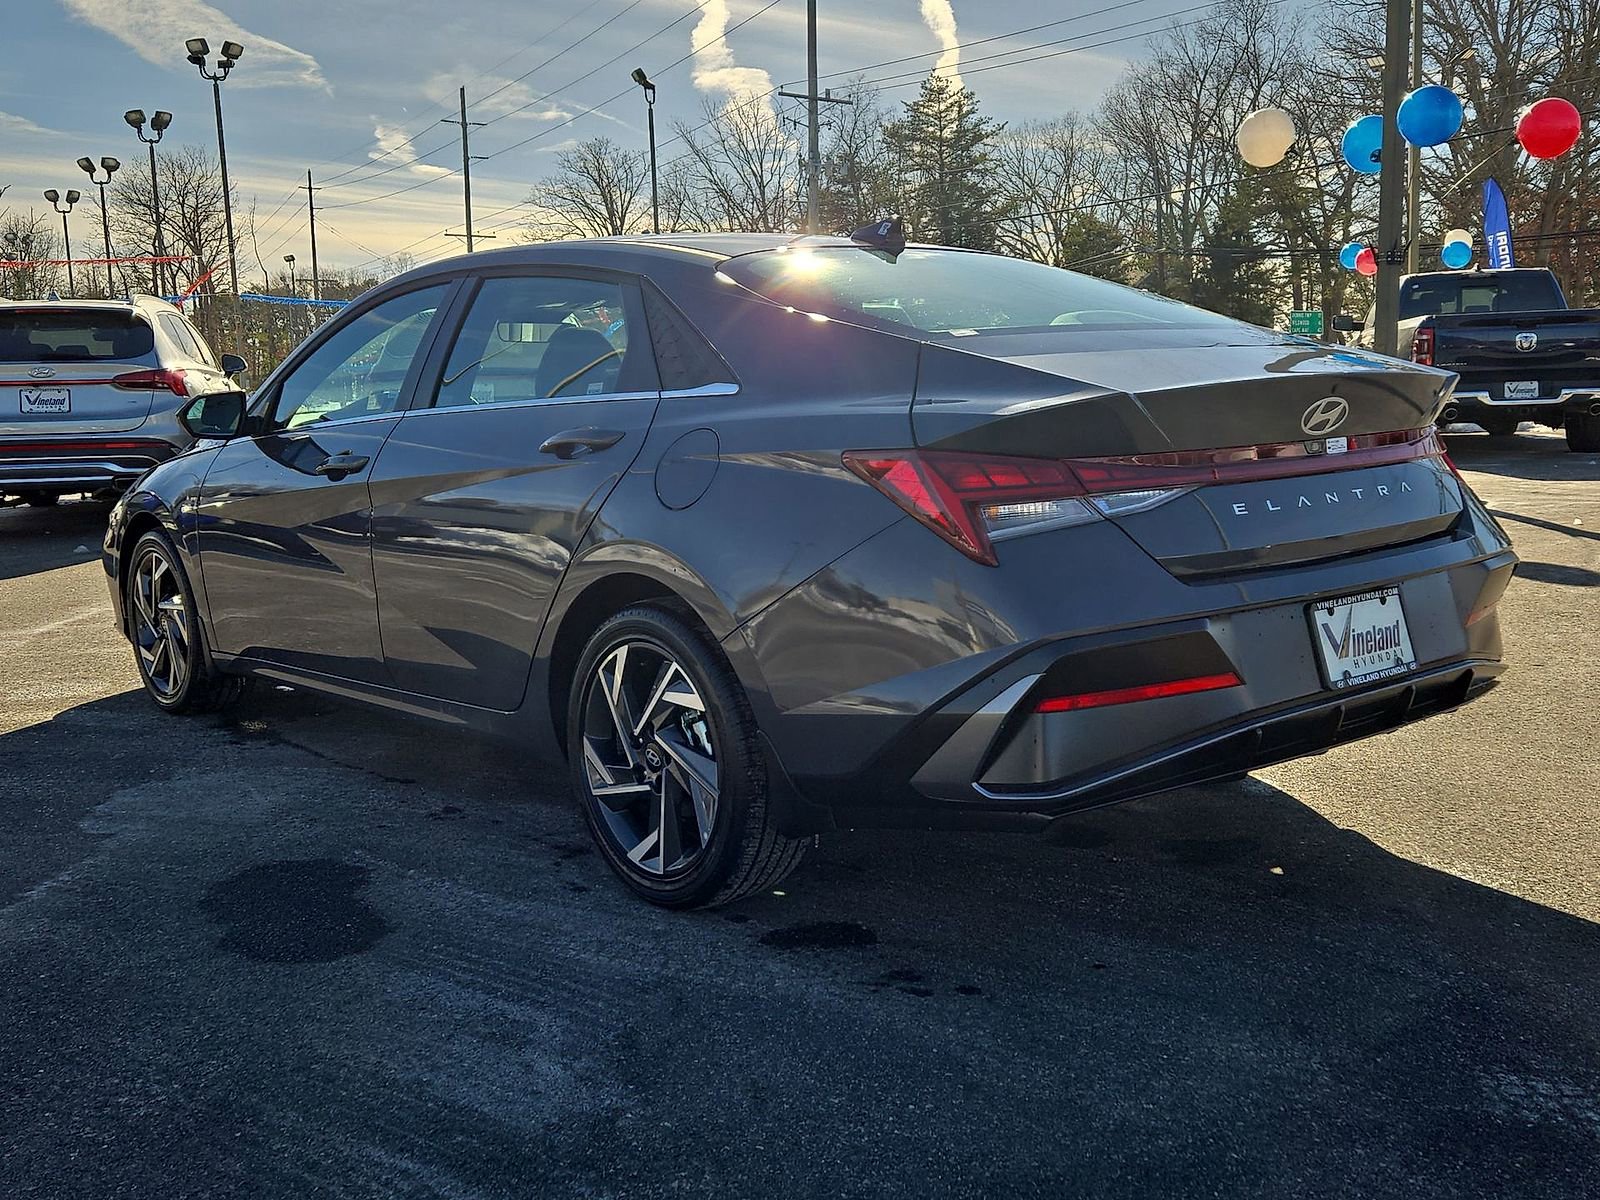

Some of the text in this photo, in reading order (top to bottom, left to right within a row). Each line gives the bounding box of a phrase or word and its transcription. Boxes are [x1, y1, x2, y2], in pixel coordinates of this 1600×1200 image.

[24, 392, 66, 406] Vineland
[1232, 481, 1412, 515] ELANTRA
[1317, 588, 1399, 610] VINELANDHYUNDAI.COM
[1321, 605, 1401, 660] Vineland
[1353, 648, 1404, 669] HYUNDAI
[1347, 664, 1408, 686] VINELAND HYUNDAI
